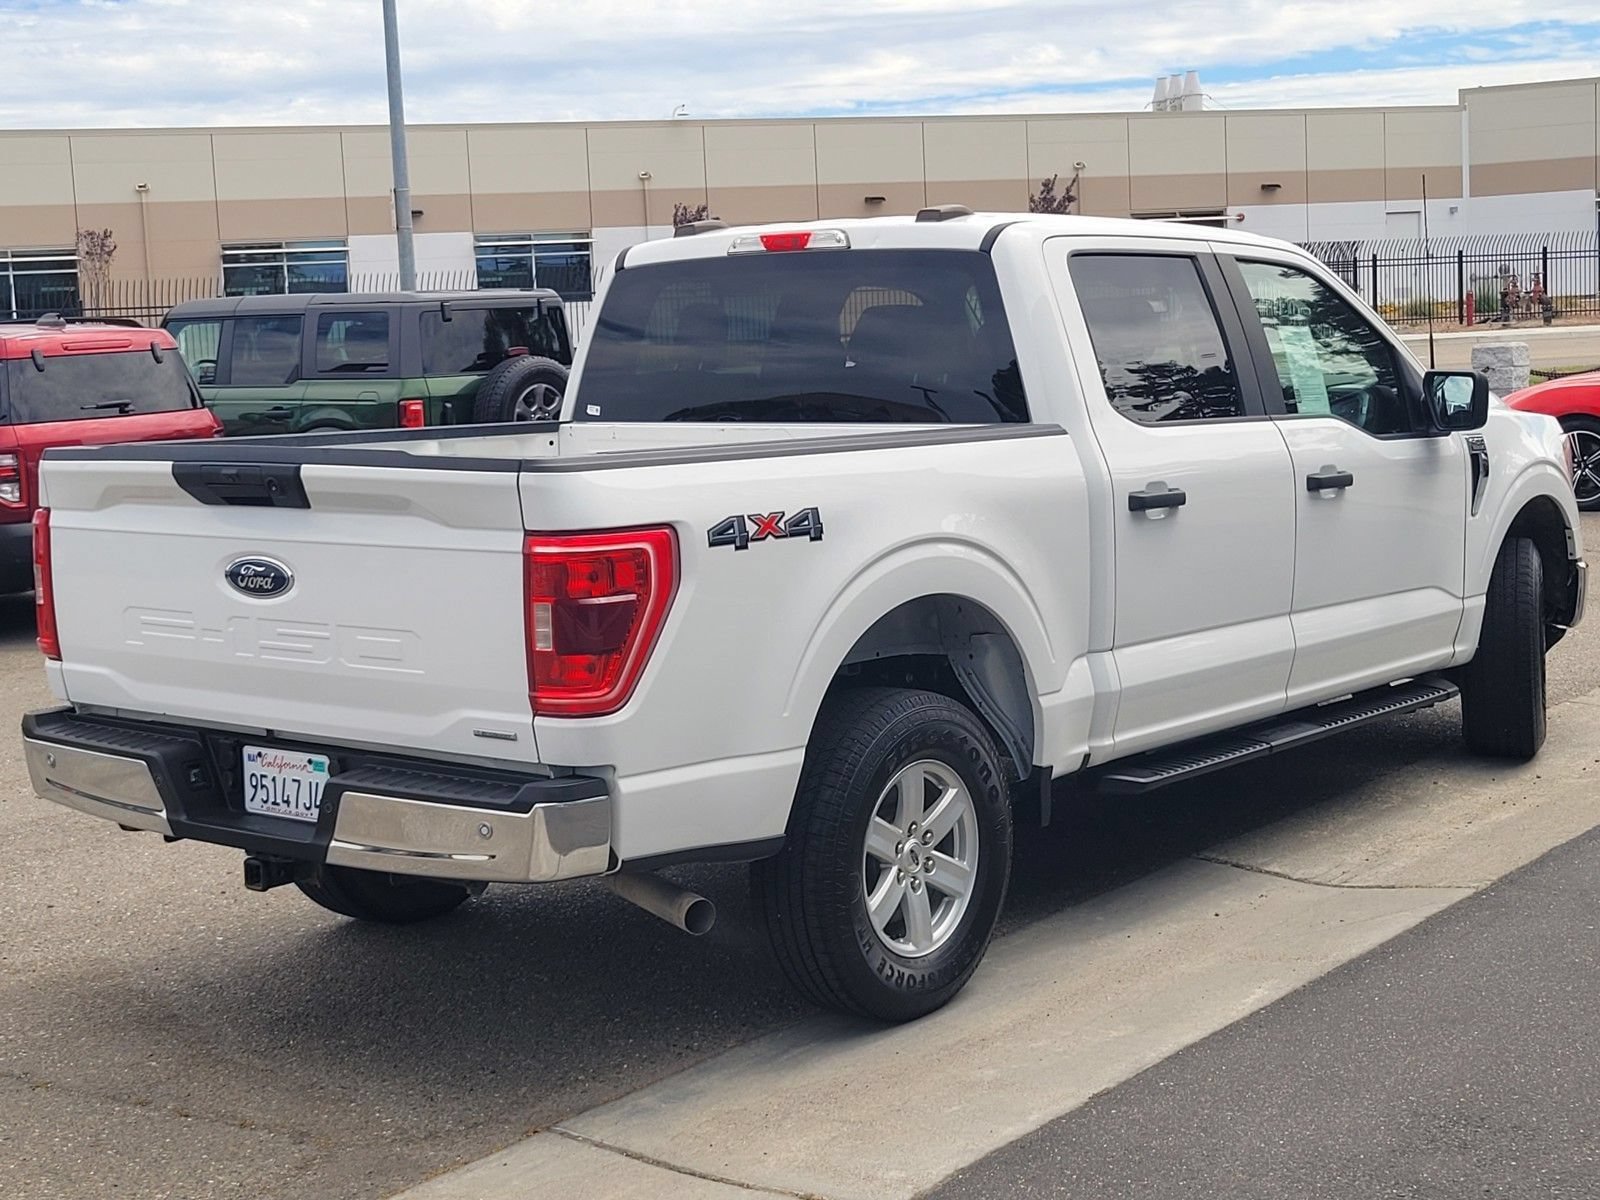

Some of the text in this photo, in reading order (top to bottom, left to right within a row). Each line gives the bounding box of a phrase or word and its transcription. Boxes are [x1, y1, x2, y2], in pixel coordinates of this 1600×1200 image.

[237, 563, 275, 590] Ford
[122, 605, 425, 674] F-150
[261, 753, 313, 774] California
